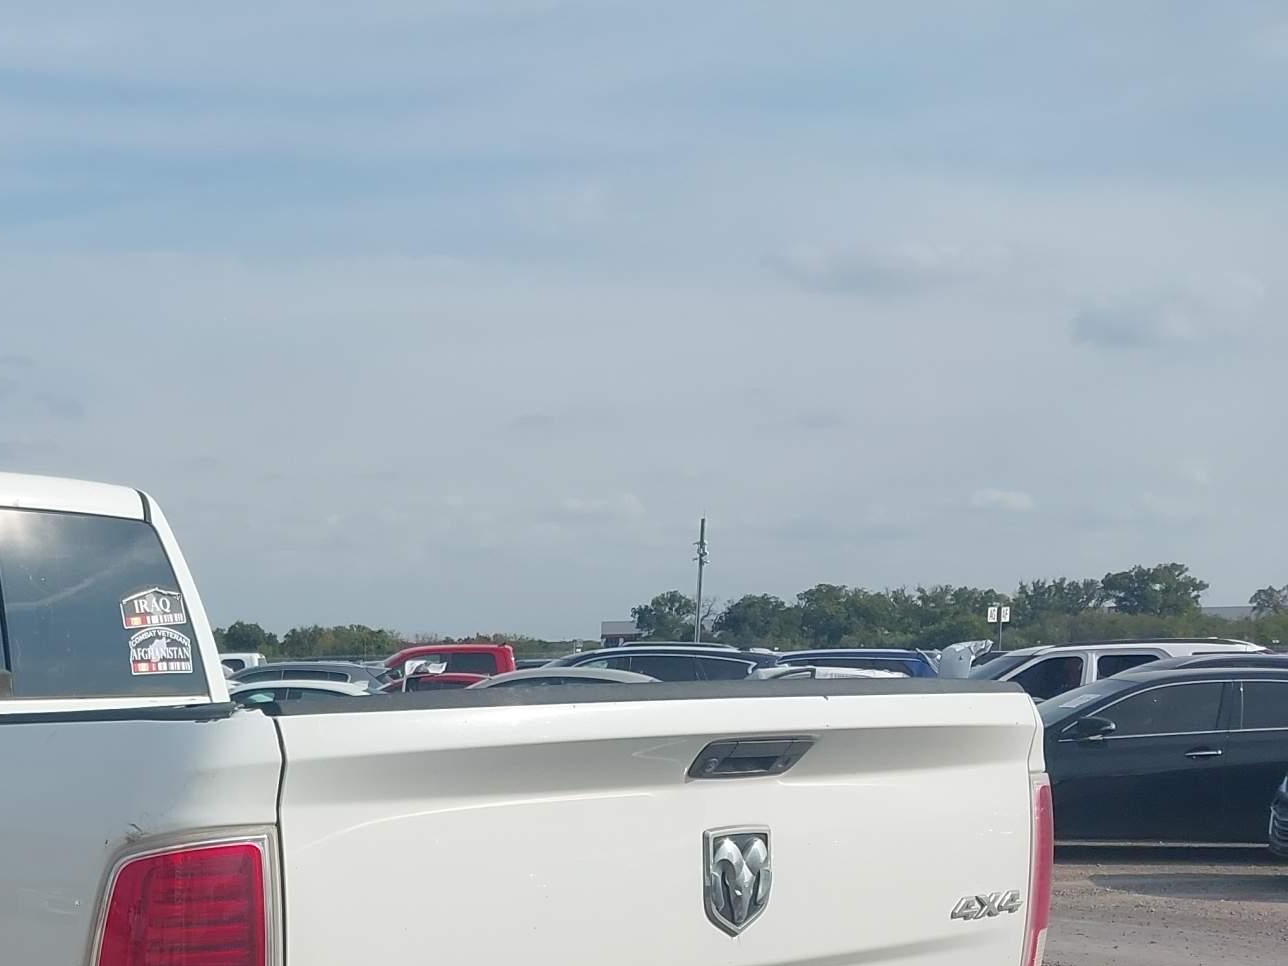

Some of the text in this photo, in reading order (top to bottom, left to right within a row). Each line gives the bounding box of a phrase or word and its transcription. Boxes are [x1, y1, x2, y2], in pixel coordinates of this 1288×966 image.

[133, 597, 171, 614] IRAQ
[131, 629, 189, 647] COMBAT VETERAN
[132, 646, 190, 660] AFGHANISTAN
